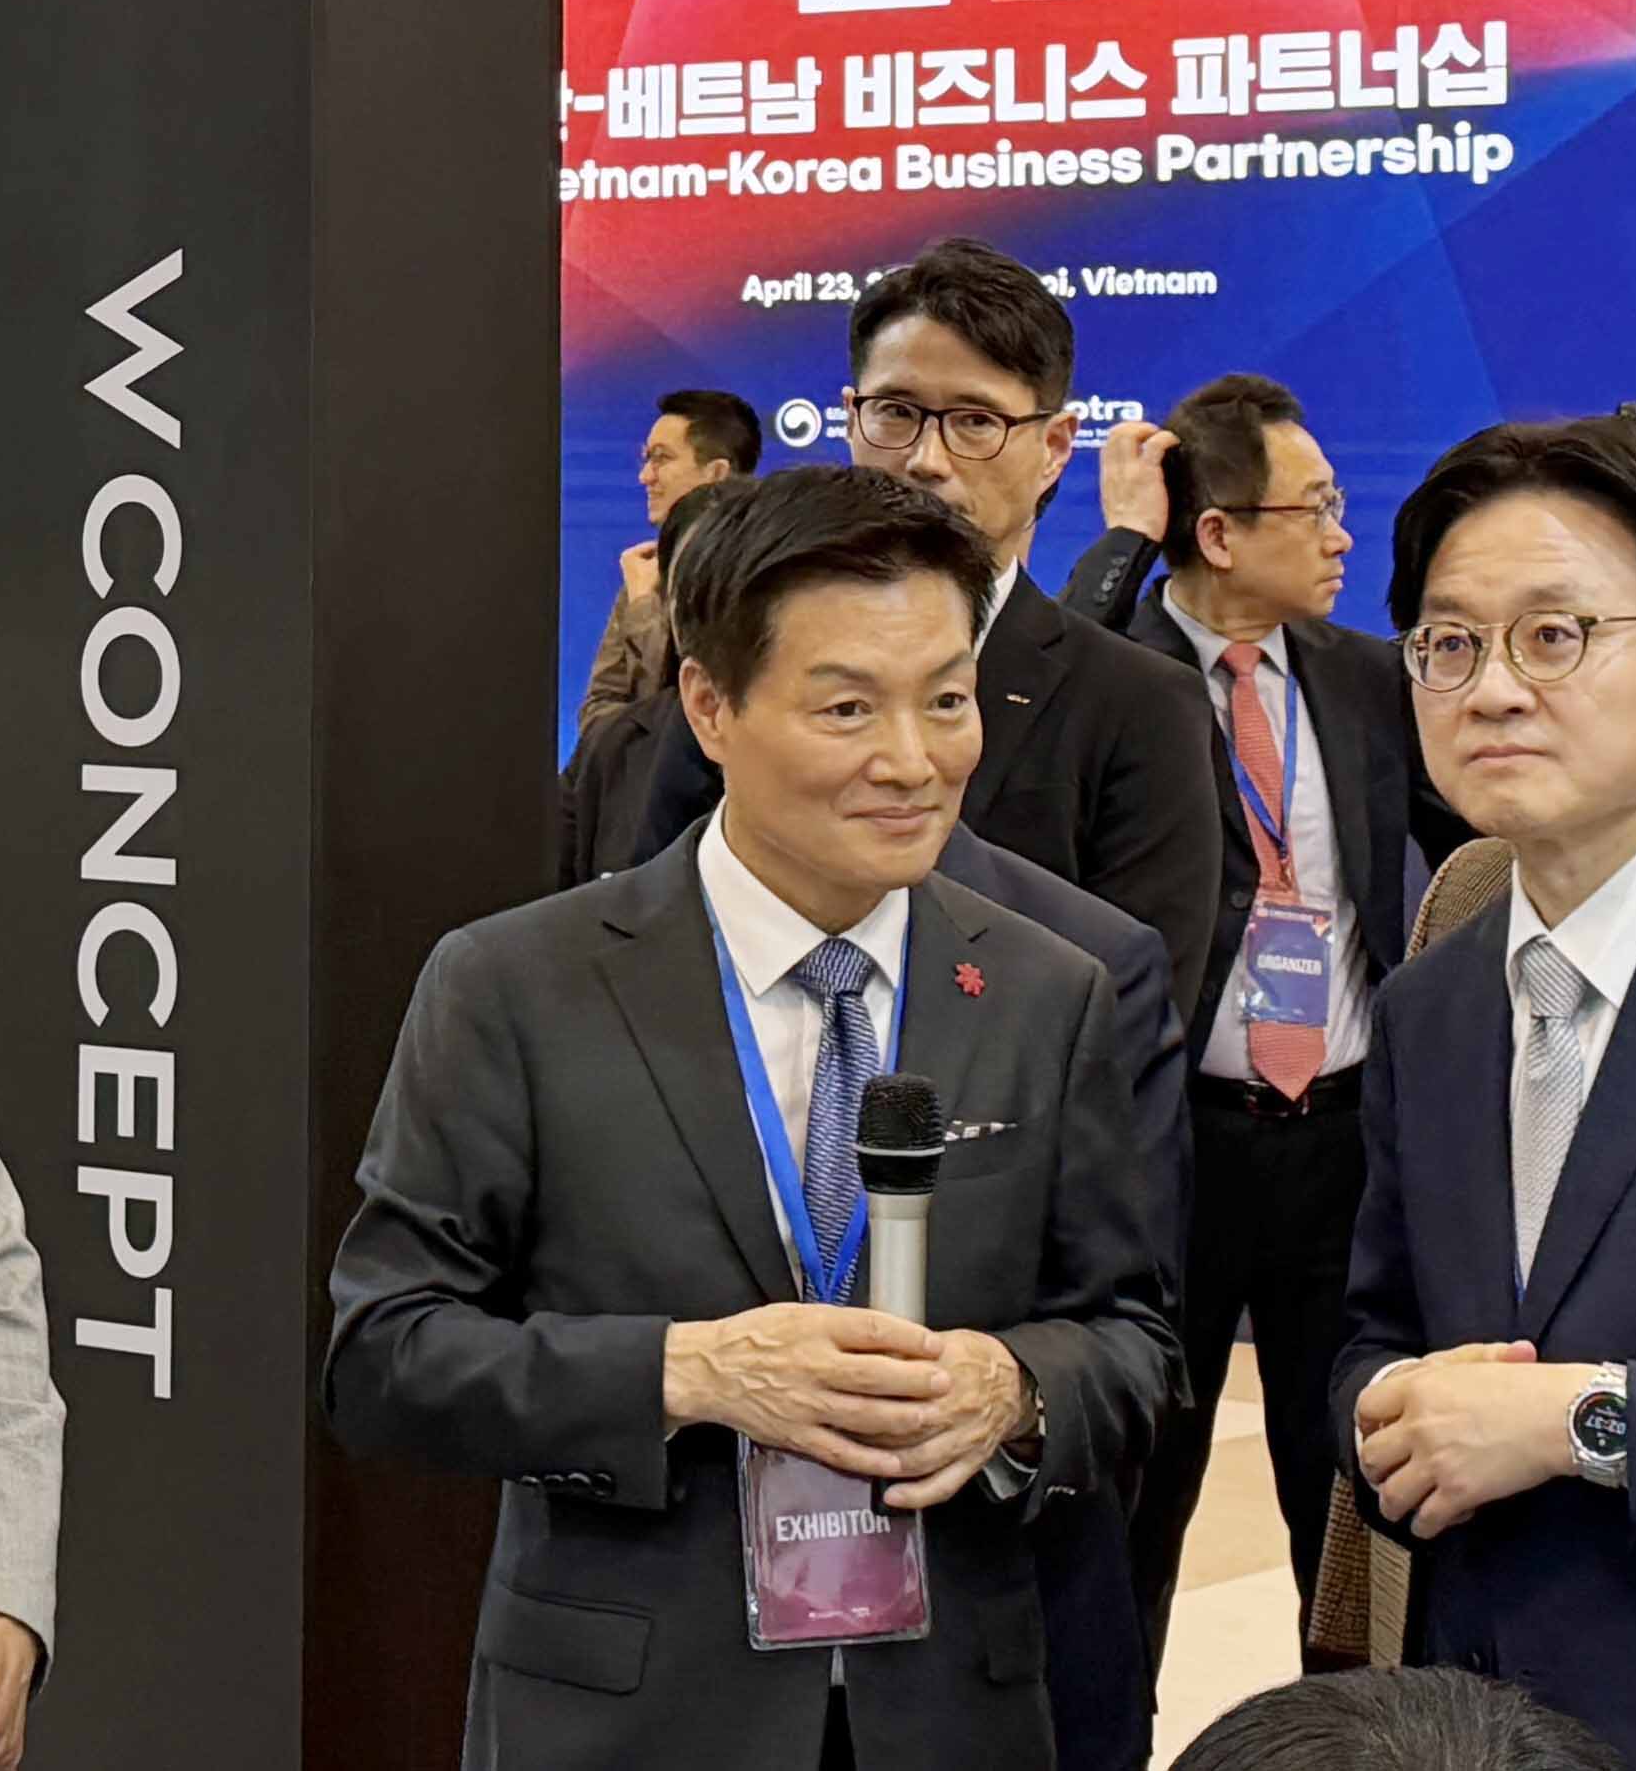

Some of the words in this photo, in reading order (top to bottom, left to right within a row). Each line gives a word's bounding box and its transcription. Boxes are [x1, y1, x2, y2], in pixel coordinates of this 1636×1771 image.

[844, 40, 1148, 129] 비즈니스
[1170, 20, 1508, 116] 파트너십
[559, 150, 882, 202] etnam-Korea
[896, 138, 1143, 190] Business
[1156, 119, 1514, 185] Partnership
[741, 272, 812, 307] April
[817, 271, 861, 303] 23,
[1082, 265, 1218, 297] Vietnam
[1064, 394, 1143, 421] otra
[775, 1508, 891, 1542] EXHIBITOR
